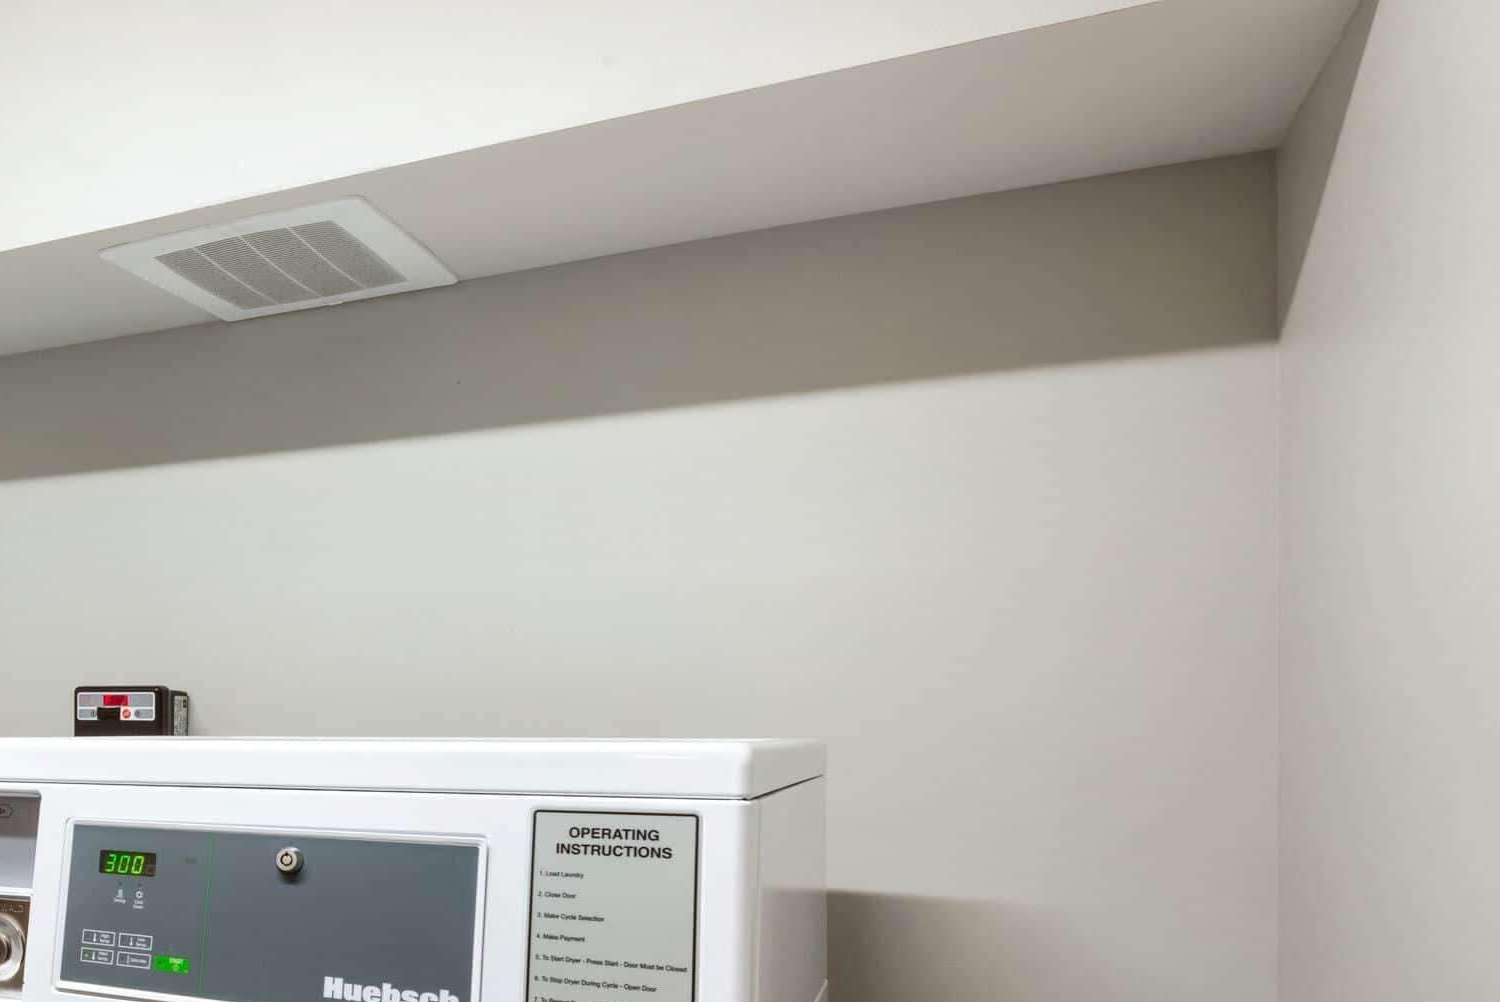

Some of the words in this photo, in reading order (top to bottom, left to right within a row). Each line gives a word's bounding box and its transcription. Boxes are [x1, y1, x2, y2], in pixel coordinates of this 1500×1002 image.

[569, 826, 660, 842] OPERATING
[556, 842, 673, 860] INSTRUCTIONS
[105, 853, 146, 875] 300
[560, 872, 584, 880] Laundry
[560, 913, 577, 921] Cycle
[559, 934, 585, 943] Payment
[565, 956, 581, 964] Dryer
[623, 961, 638, 969] Door
[665, 964, 688, 973] Closed
[564, 978, 580, 986] Dryer
[581, 979, 601, 989] During
[602, 981, 619, 990] Cycle
[623, 983, 641, 992] Open
[641, 984, 657, 993] Door
